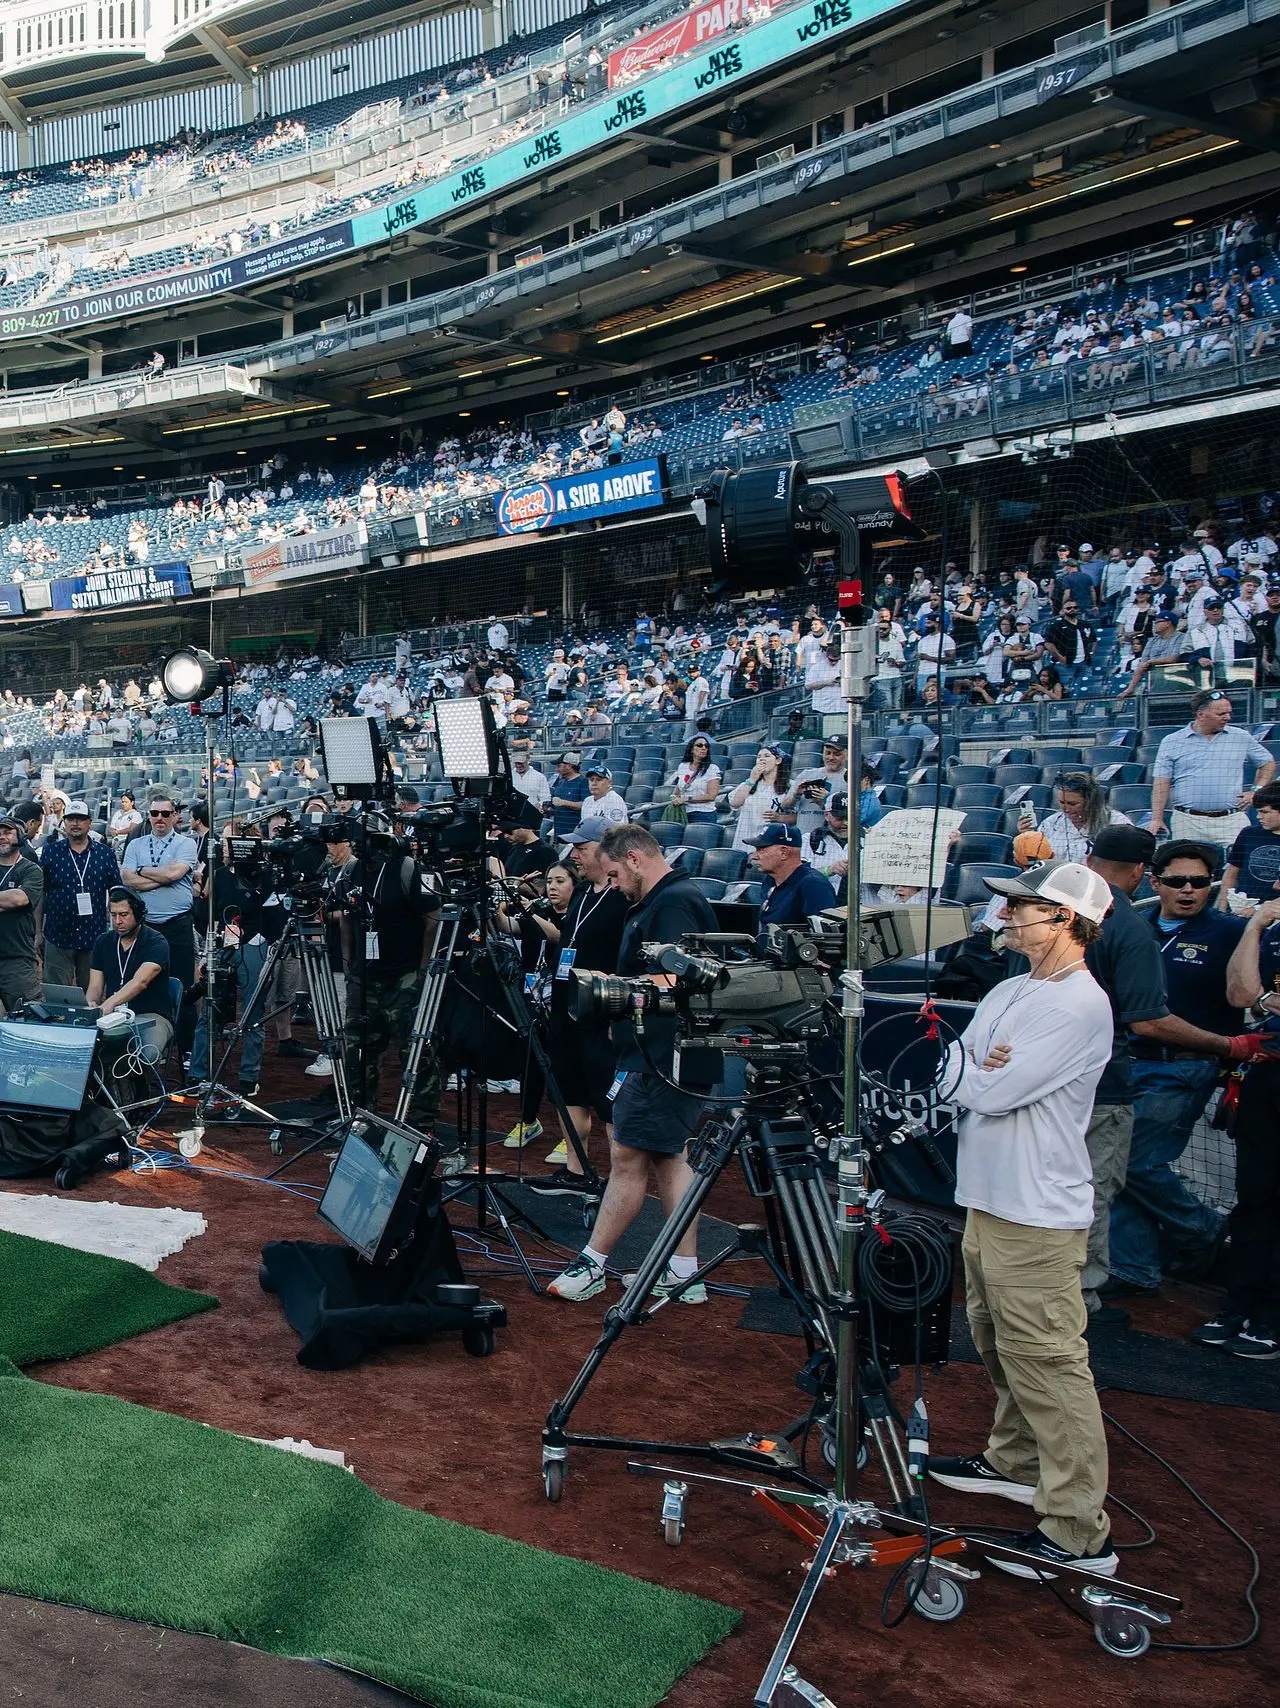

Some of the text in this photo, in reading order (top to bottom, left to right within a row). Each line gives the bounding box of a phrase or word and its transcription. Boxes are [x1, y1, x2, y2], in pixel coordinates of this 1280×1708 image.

[797, 8, 852, 43] VOTES
[622, 34, 683, 68] Budweiser
[709, 44, 739, 70] NYC
[694, 58, 743, 89] VOTES
[1039, 67, 1076, 93] 1937
[617, 90, 644, 115] NYC
[604, 102, 647, 132] VOTES
[535, 131, 559, 151] NYC
[523, 141, 561, 168] VOTES
[462, 167, 484, 185] NYC
[793, 159, 822, 186] 1936
[451, 178, 486, 201] VOTES
[395, 199, 415, 216] NYC
[383, 211, 418, 233] VOTES
[630, 226, 653, 246] 1932
[245, 256, 267, 269] Message
[298, 241, 310, 253] may
[246, 265, 268, 277] Message
[268, 259, 282, 270] HELP
[304, 246, 319, 258] STOP
[2, 309, 60, 335] 809-4227
[62, 304, 80, 323] TO
[82, 297, 113, 318] JOIN
[115, 291, 144, 312] OUR
[146, 269, 233, 307] COMMUNITY!
[314, 338, 335, 351] 1927
[557, 471, 654, 511] A SUB ABOVE
[774, 470, 787, 499] Aputure
[506, 489, 545, 514] Jersey
[286, 533, 356, 569] AMAZING
[1240, 541, 1259, 555] 99
[86, 567, 156, 592] JOHN STERLING &
[71, 590, 98, 609] SUZYN
[99, 585, 140, 605] WALDMAN
